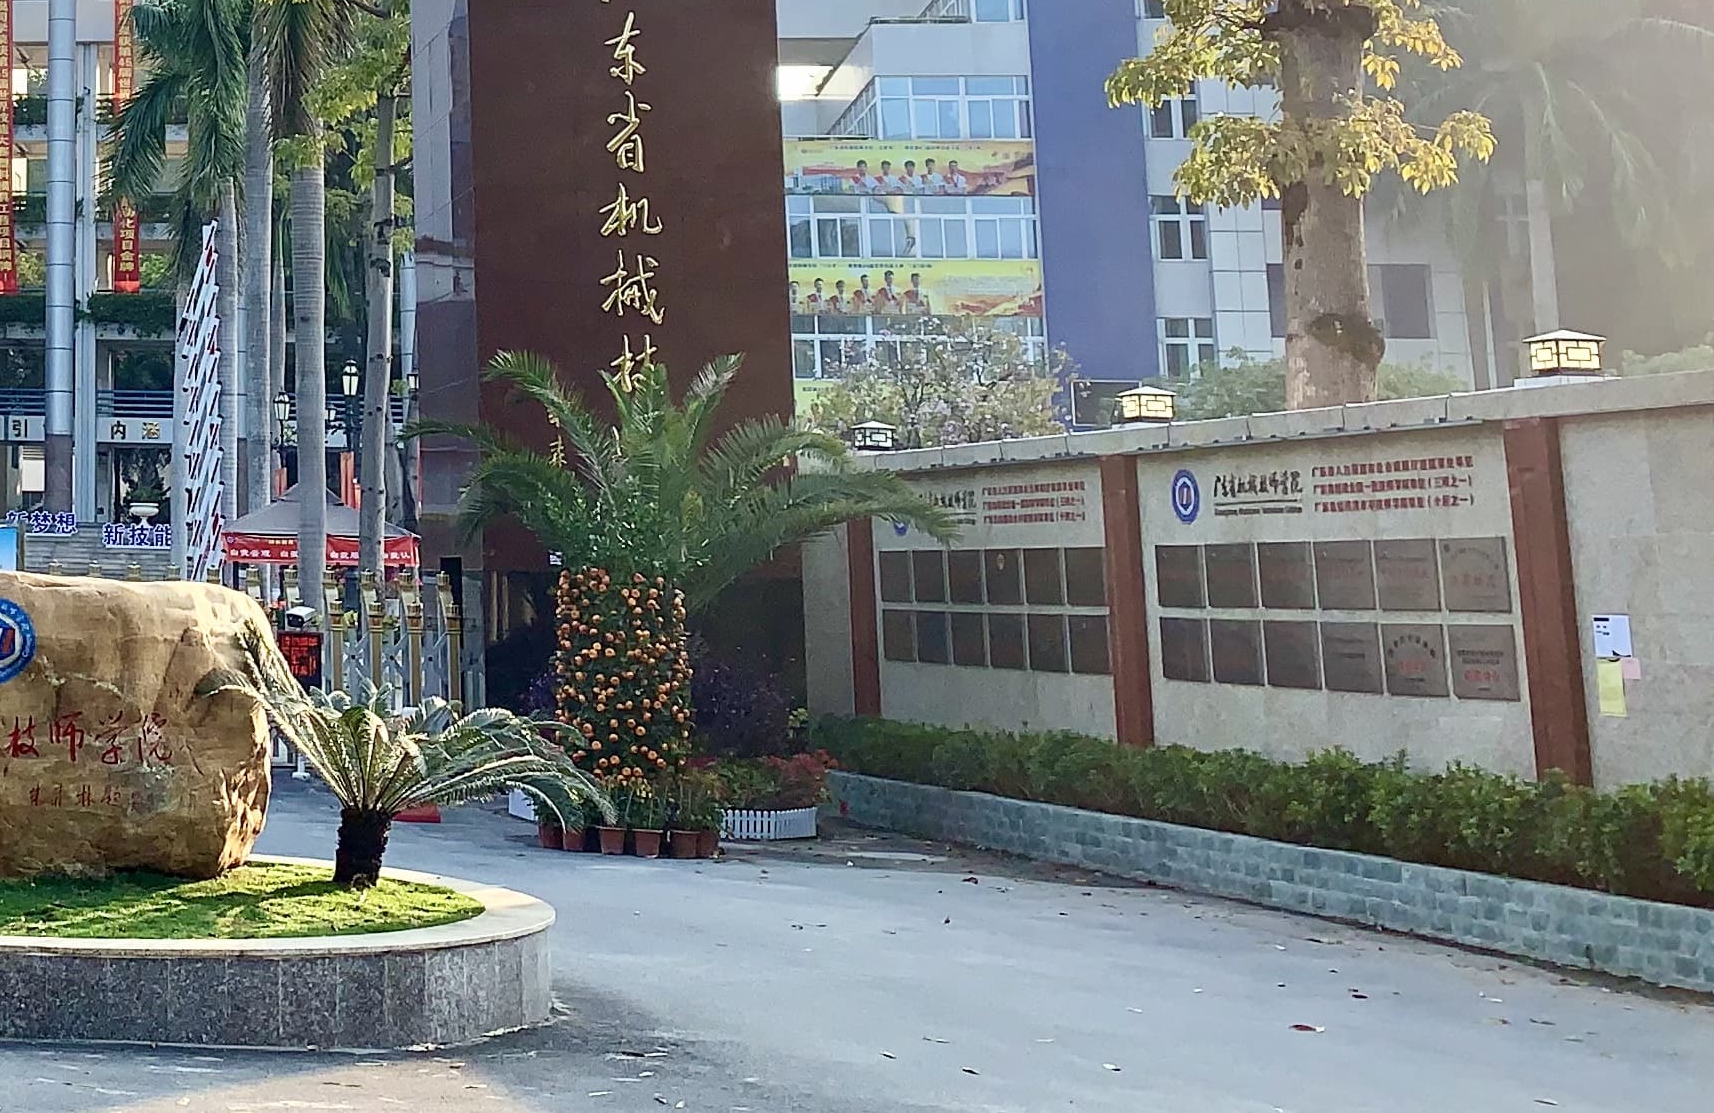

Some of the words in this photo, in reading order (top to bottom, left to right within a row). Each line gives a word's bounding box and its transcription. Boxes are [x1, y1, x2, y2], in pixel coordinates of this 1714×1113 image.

[110, 421, 160, 440] 内涵
[102, 523, 171, 547] 新技能
